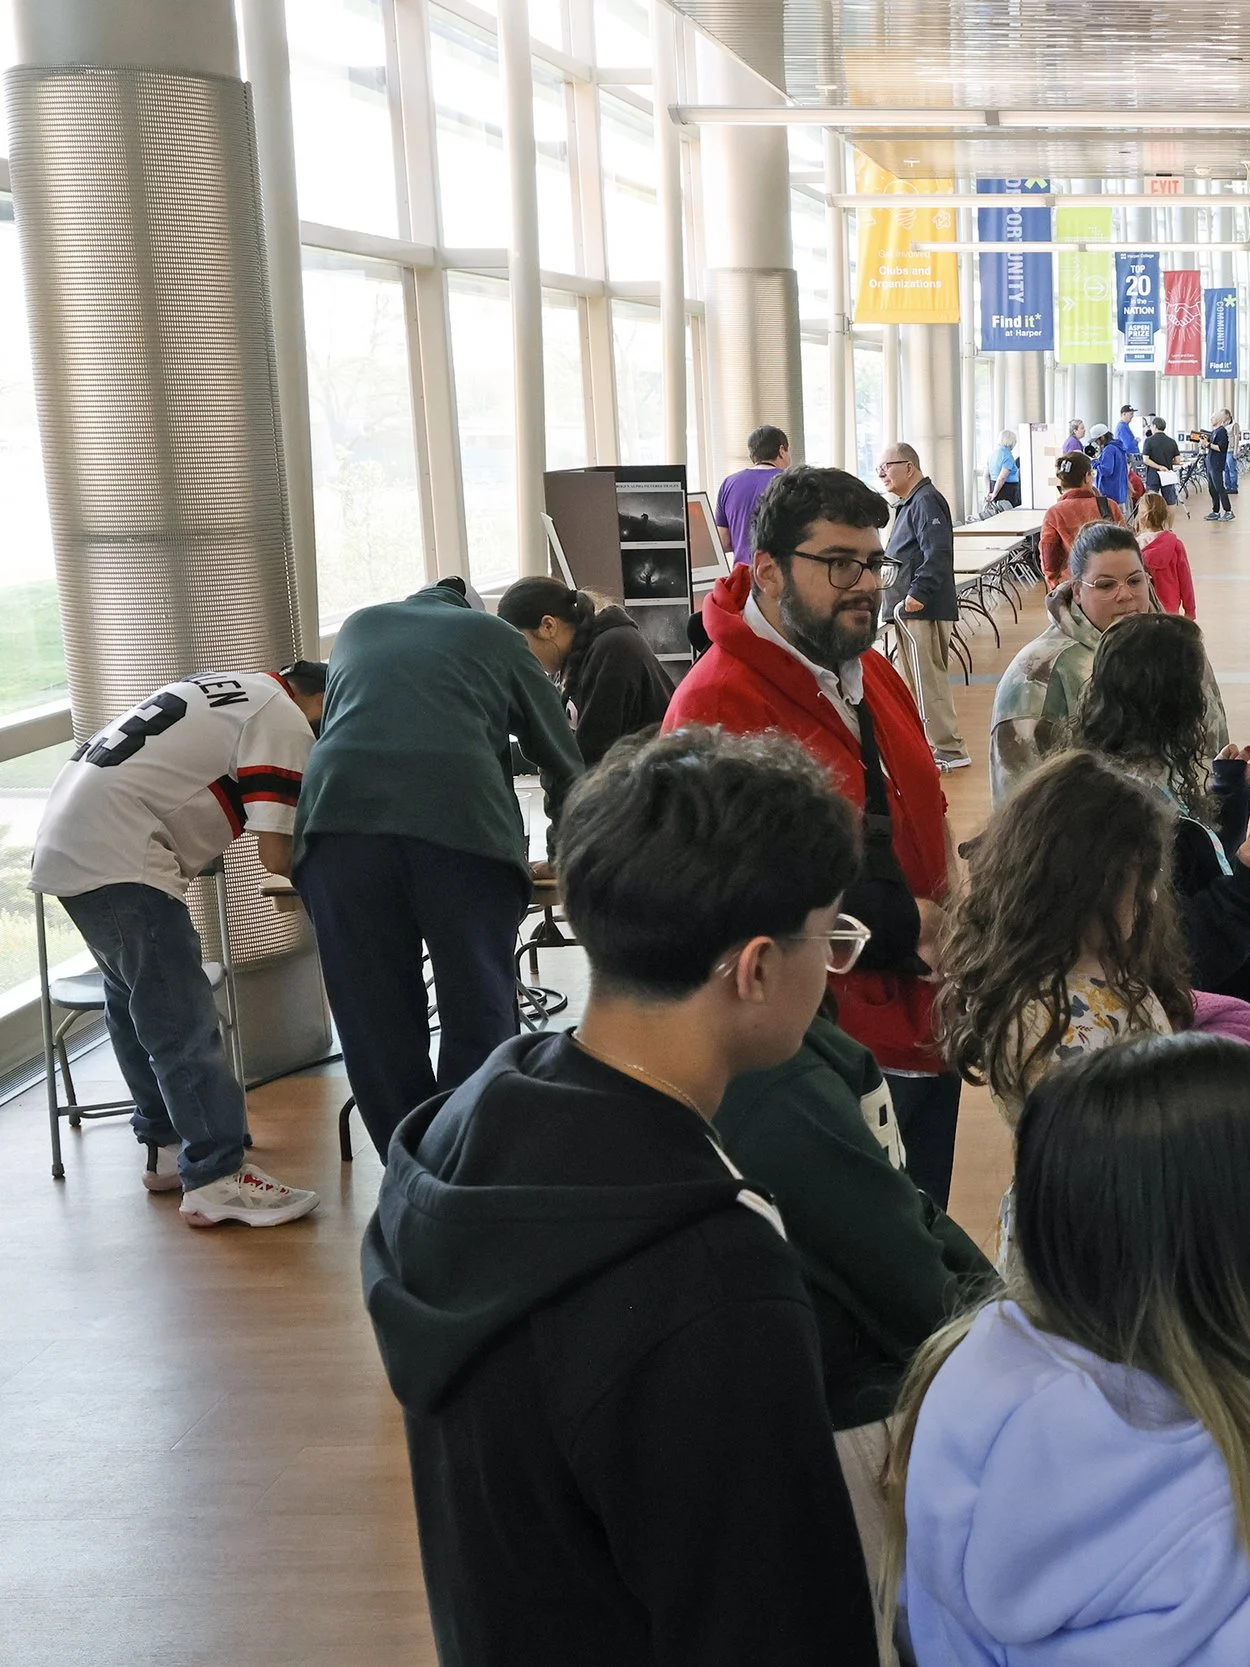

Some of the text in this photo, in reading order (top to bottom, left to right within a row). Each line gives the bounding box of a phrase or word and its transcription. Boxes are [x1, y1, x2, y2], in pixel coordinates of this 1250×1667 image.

[879, 265, 932, 276] Clubs and
[1130, 264, 1146, 274] TOP
[868, 278, 943, 290] Organizations
[1125, 275, 1152, 297] 20
[1123, 305, 1155, 316] NATION
[991, 315, 1022, 329] Find
[1216, 301, 1225, 352] COMMUNITY
[1015, 329, 1042, 339] Harper
